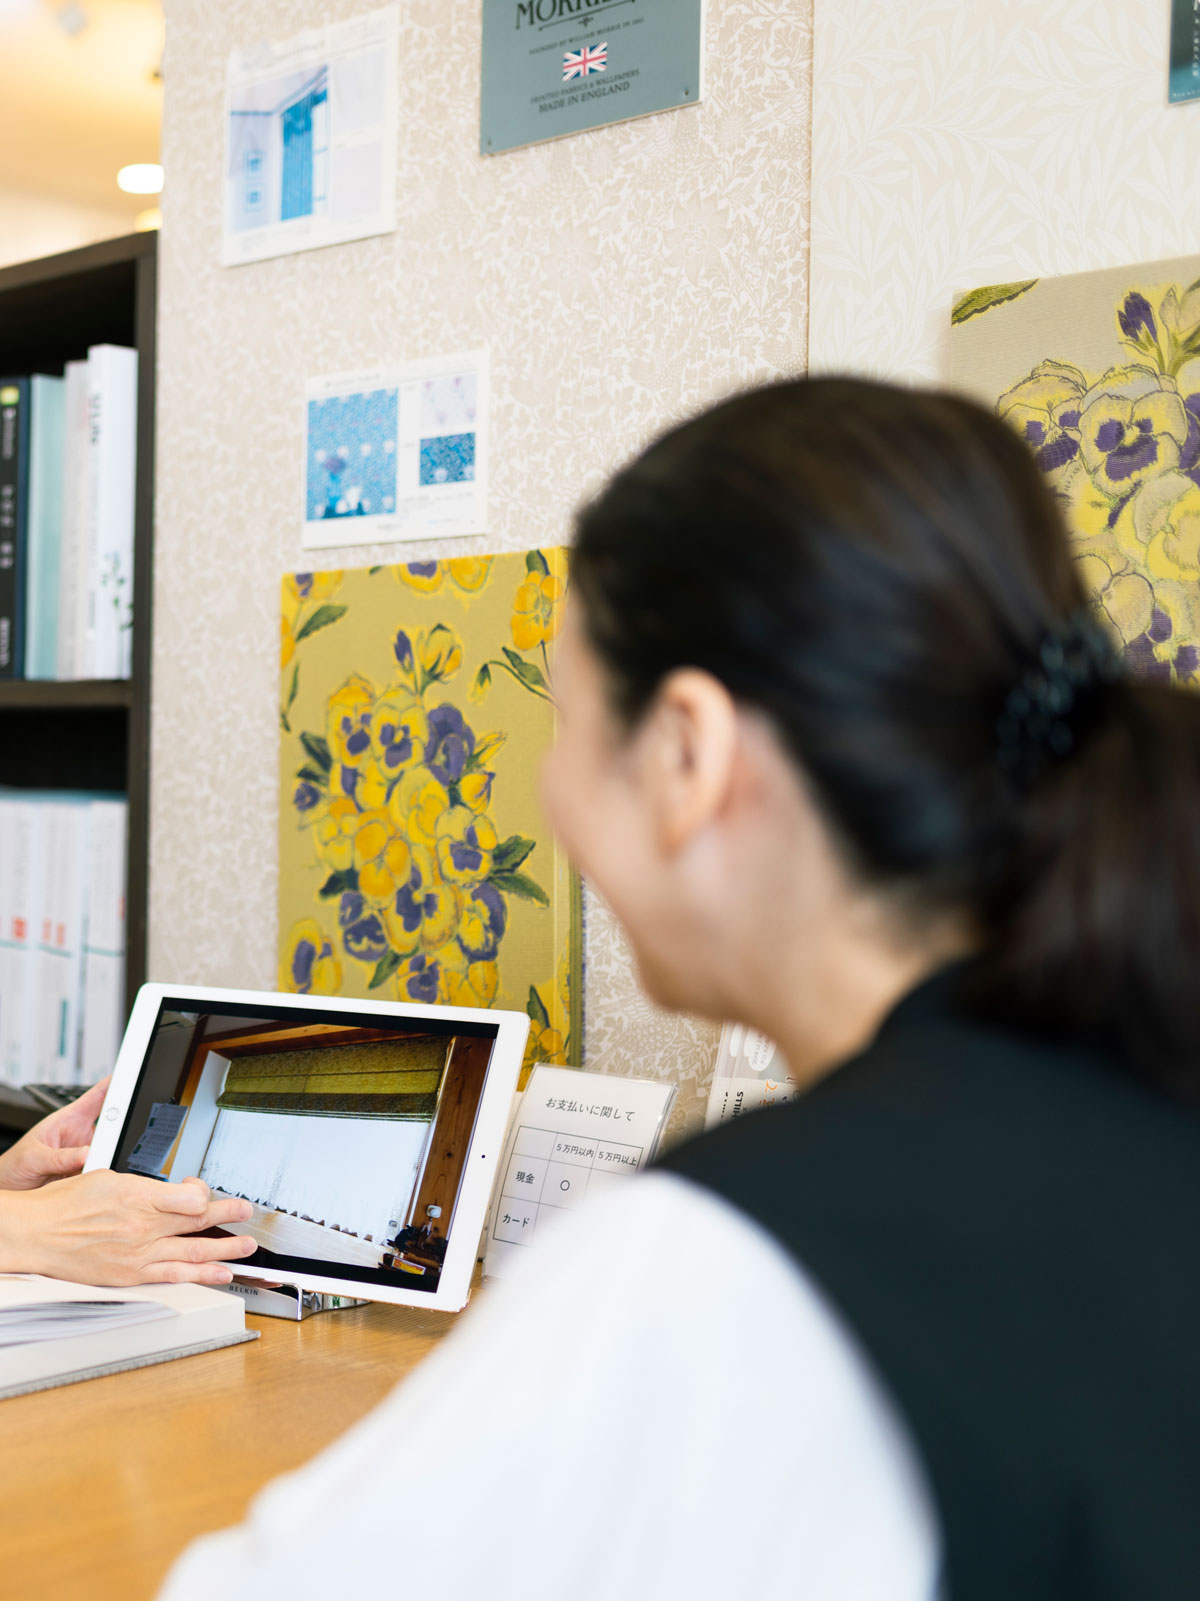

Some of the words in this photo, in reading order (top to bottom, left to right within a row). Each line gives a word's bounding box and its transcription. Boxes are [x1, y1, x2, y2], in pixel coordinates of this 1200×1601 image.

[515, 0, 612, 30] MOR
[595, 68, 640, 86] WALLPAPERS
[538, 99, 566, 113] MADE
[567, 95, 579, 106] IN
[580, 81, 631, 103] ENGLAND
[545, 1097, 636, 1122] お支払いに関して
[515, 1171, 535, 1185] 現金
[502, 1213, 530, 1228] カード
[229, 1284, 259, 1296] BELKIN
